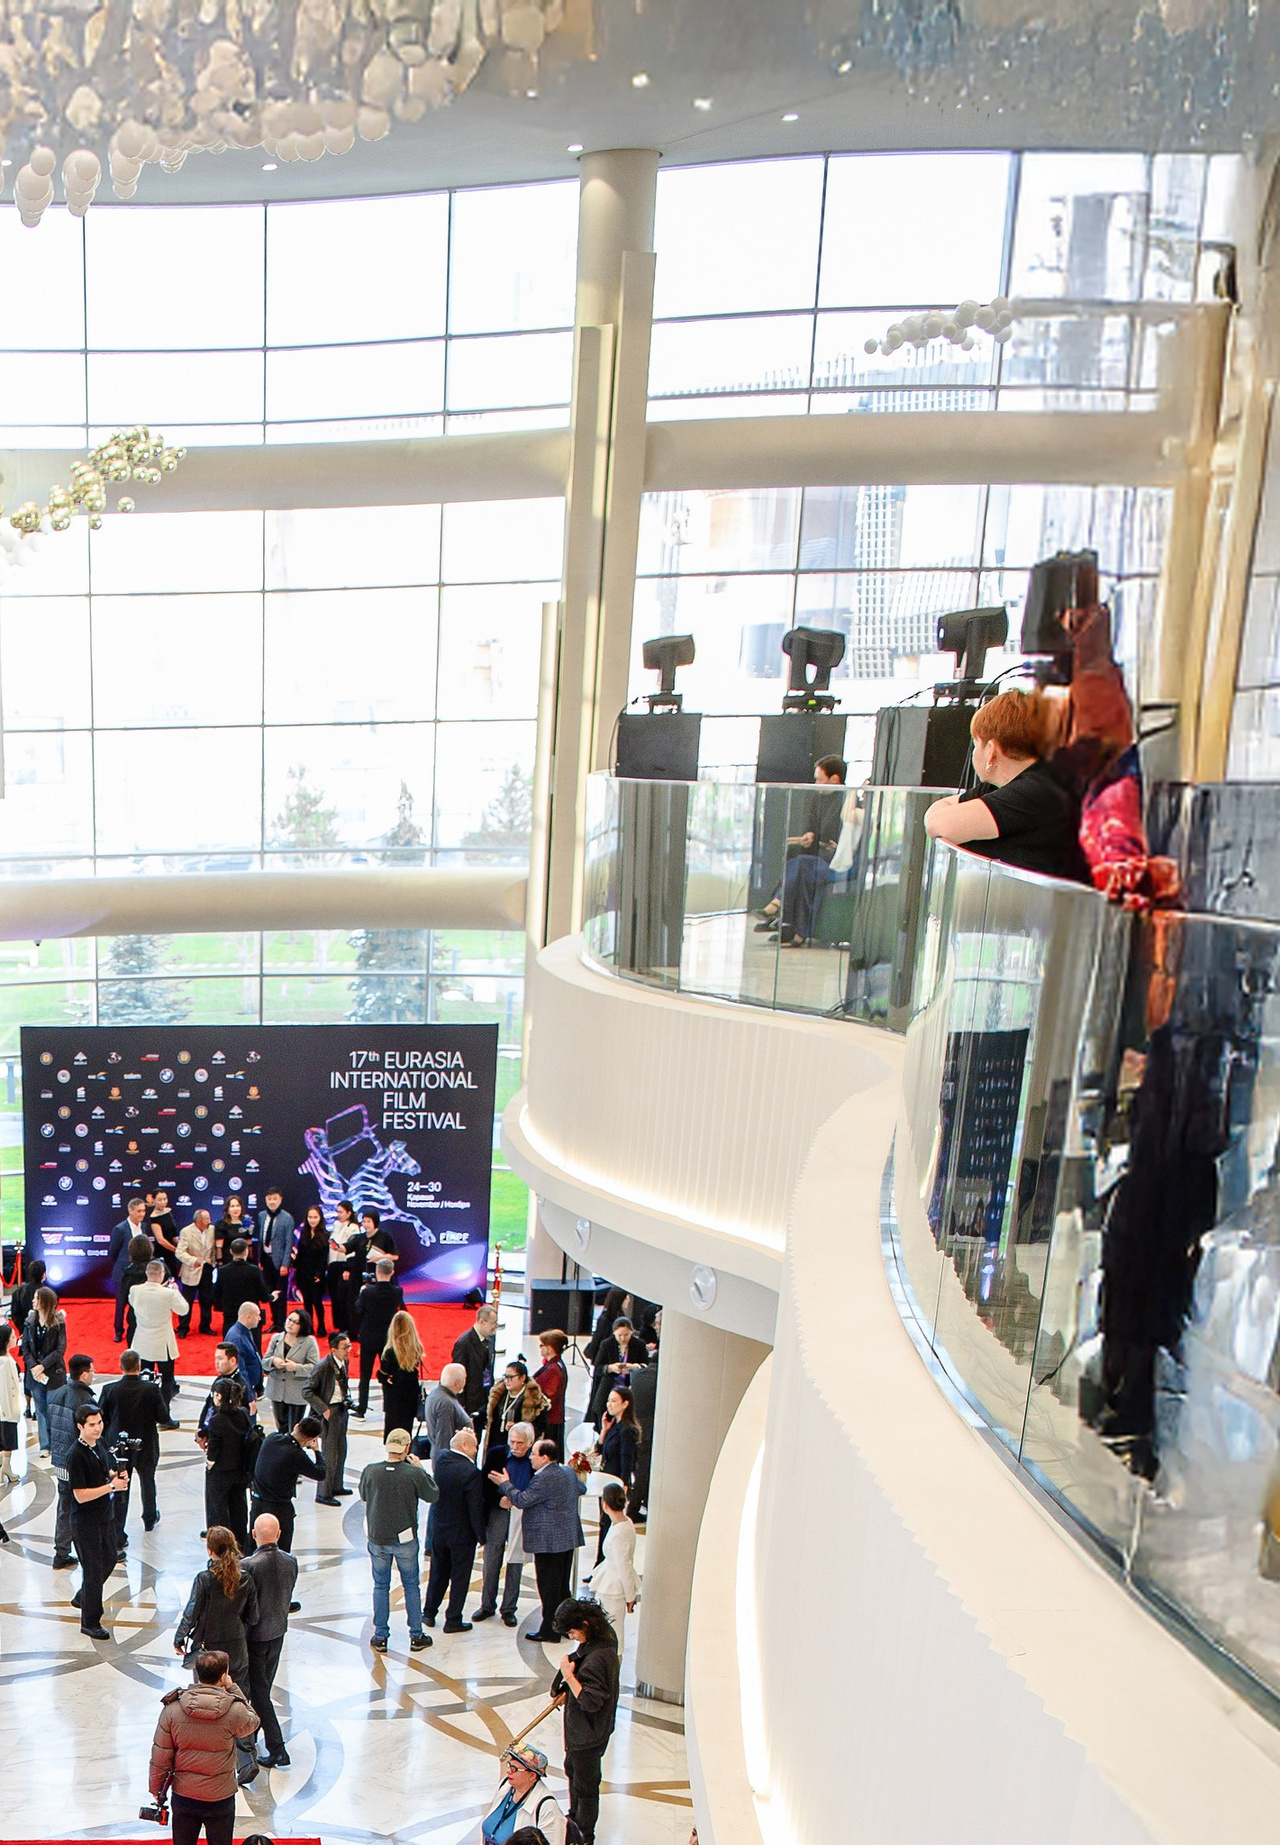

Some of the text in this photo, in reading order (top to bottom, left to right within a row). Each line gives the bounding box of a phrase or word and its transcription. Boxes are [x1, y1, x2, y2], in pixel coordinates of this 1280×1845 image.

[349, 1051, 464, 1069] 17th EURASIA
[330, 1071, 479, 1089] INTERNATIONAL
[383, 1092, 426, 1109] FILM
[382, 1112, 467, 1130] FESTIVAL
